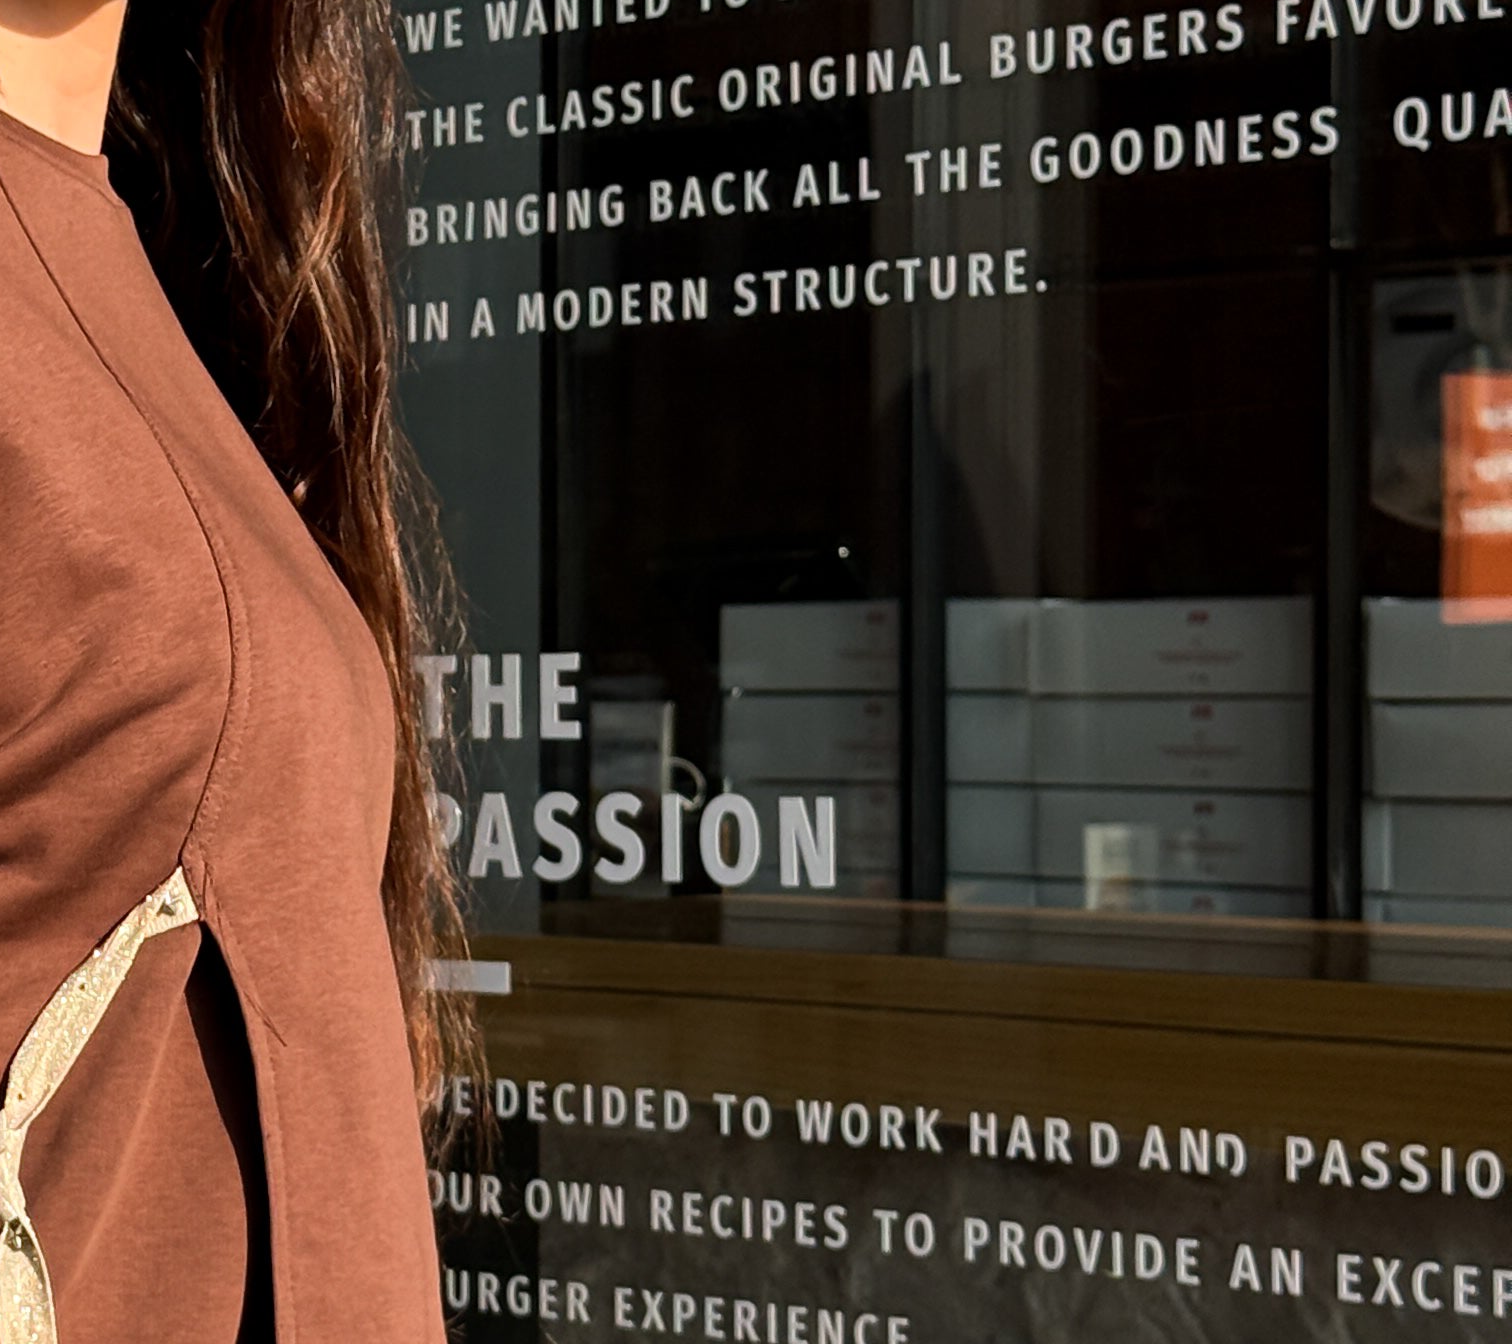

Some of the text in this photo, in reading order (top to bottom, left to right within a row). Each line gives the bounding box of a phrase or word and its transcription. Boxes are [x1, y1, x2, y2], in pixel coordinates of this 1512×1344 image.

[406, 7, 464, 53] WE
[406, 102, 485, 150] THE
[506, 74, 696, 139] CLASSIC
[718, 40, 963, 112] ORIGINAL
[990, 3, 1245, 80] BURGERS
[408, 185, 625, 248] BRINGING
[649, 168, 771, 223] BACK
[792, 157, 882, 209] ALL
[906, 142, 1003, 196] THE
[1029, 106, 1341, 186] GOODNESS
[407, 249, 1050, 344] IN A MODERN STRUCTURE.
[416, 651, 583, 741] THE
[495, 1077, 690, 1133] DECIDED
[712, 1092, 773, 1140] TO
[795, 1098, 944, 1155] WORK
[1285, 1134, 1505, 1200] PASSIO
[524, 1177, 626, 1229] OWN
[650, 1187, 850, 1251] RECIPES
[872, 1208, 937, 1259] TO
[963, 1216, 1201, 1288] PROVIDE
[1229, 1242, 1304, 1297] AN
